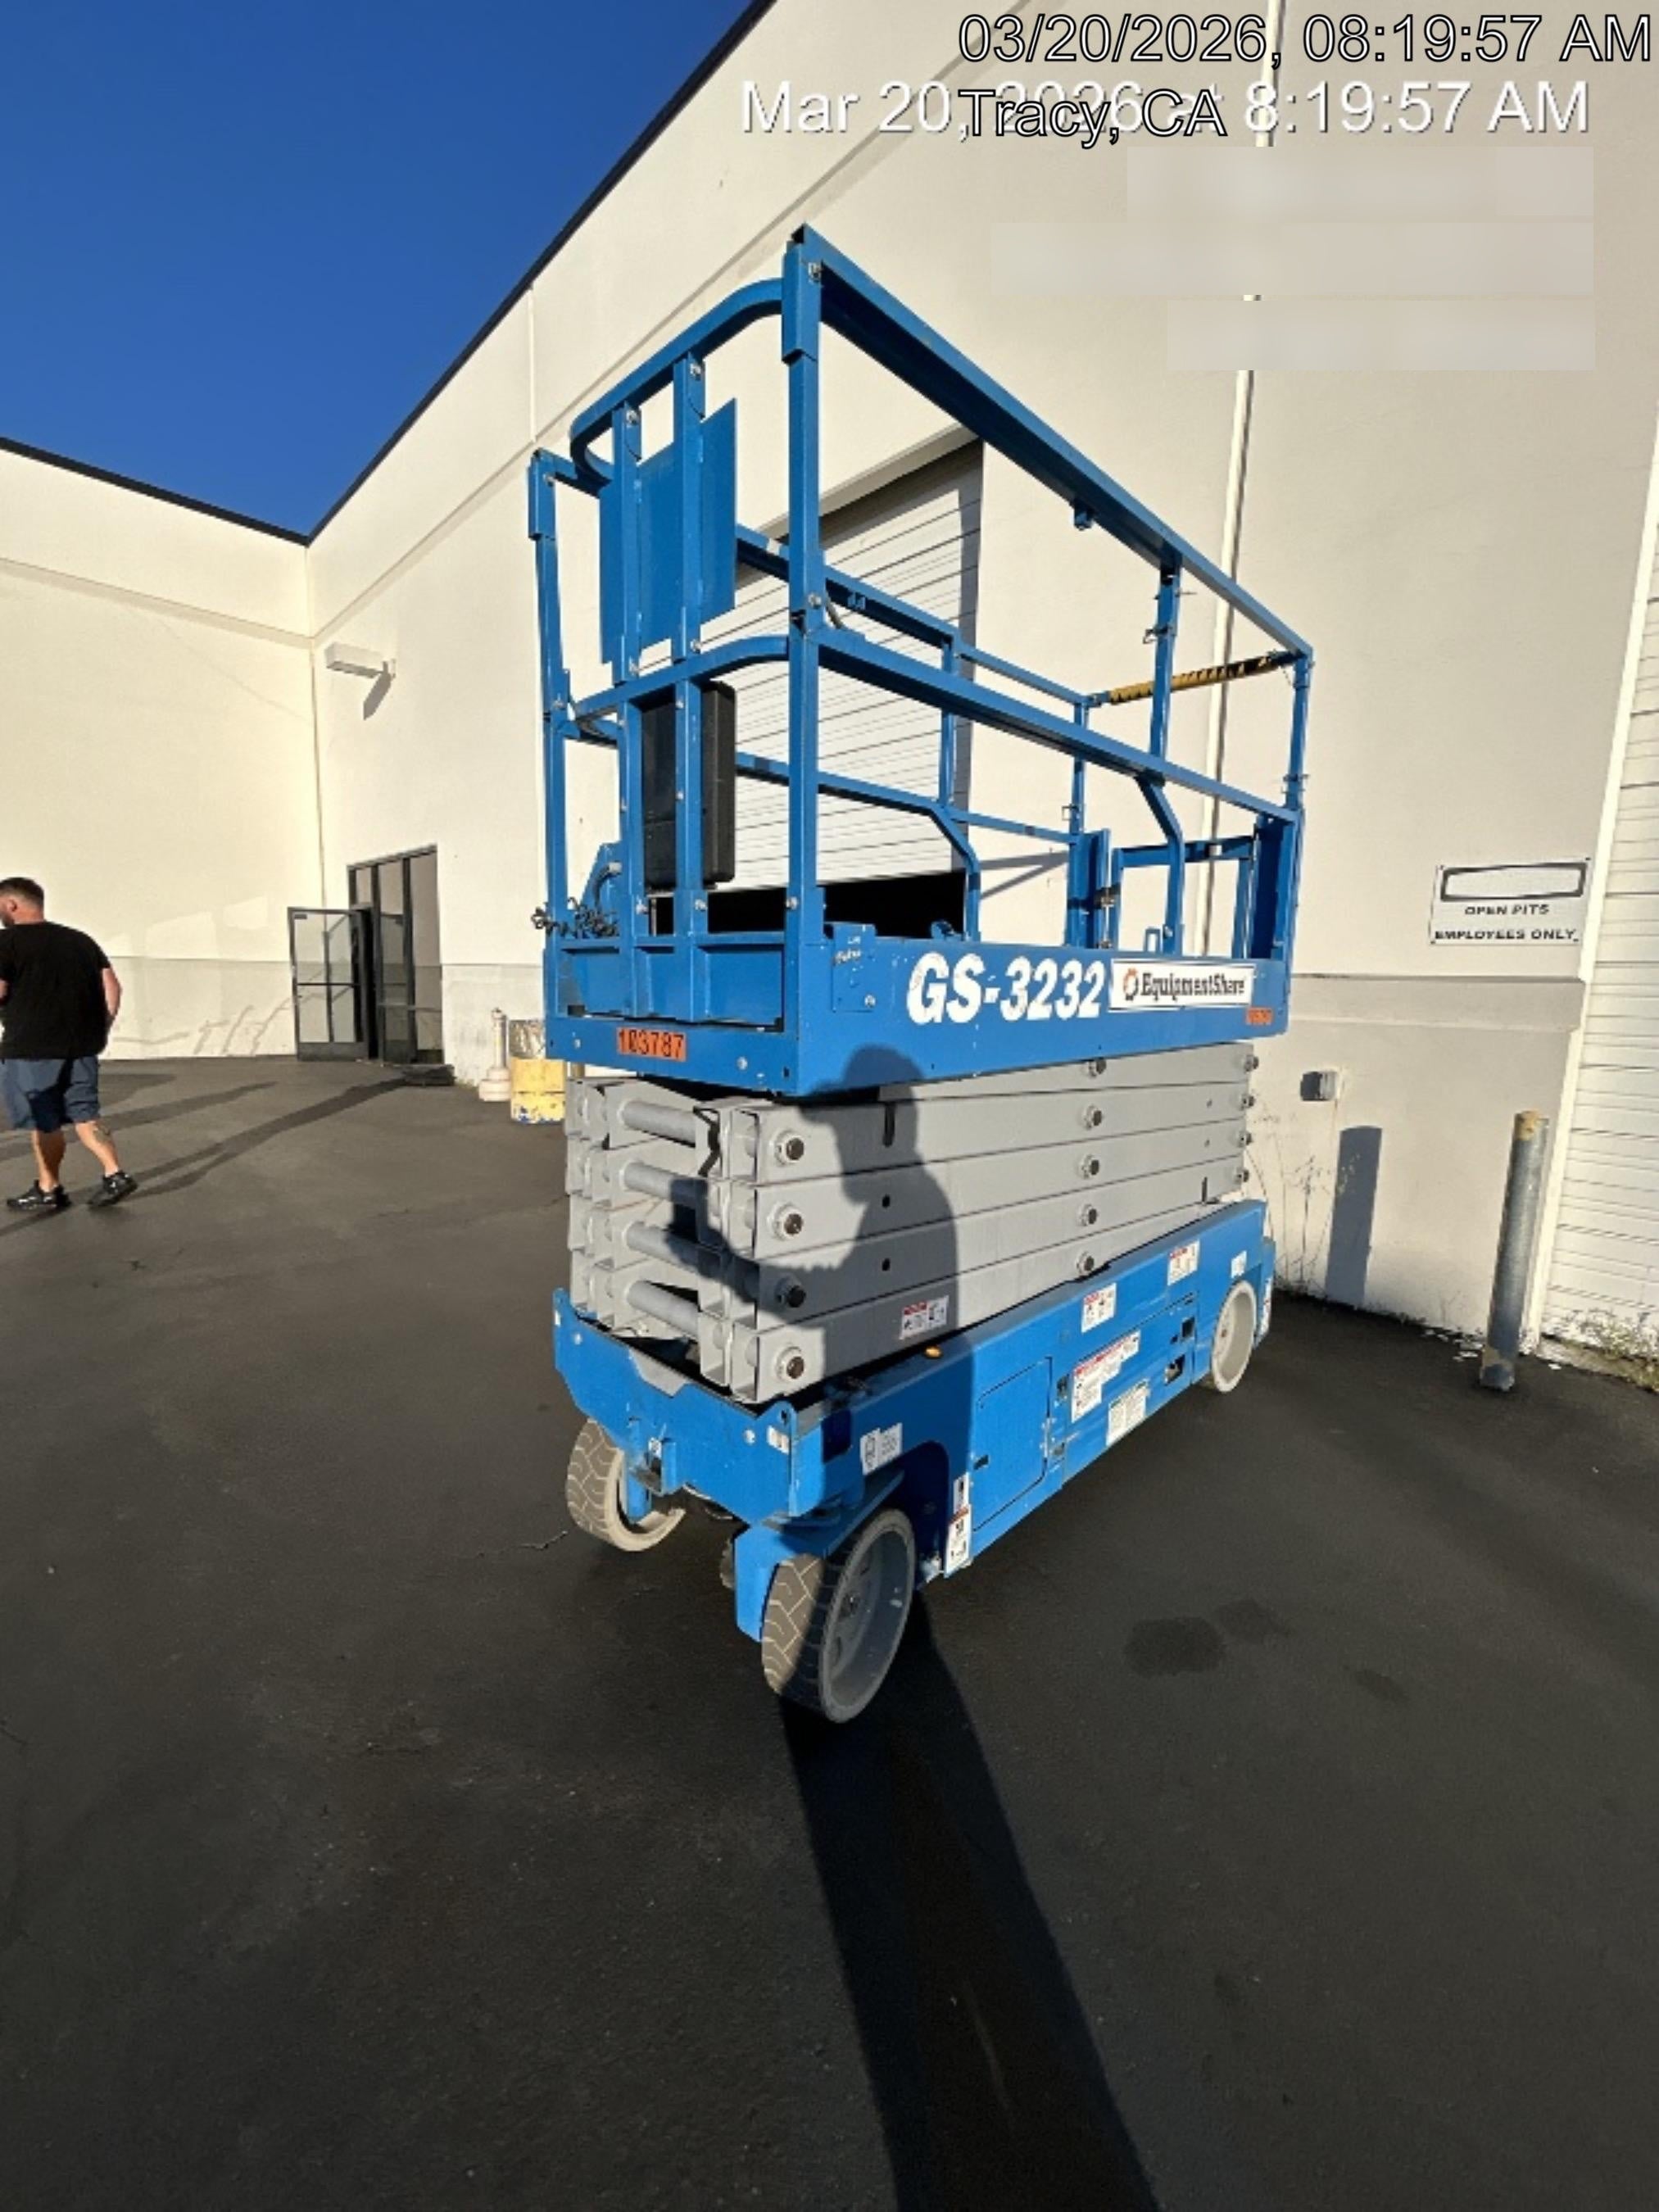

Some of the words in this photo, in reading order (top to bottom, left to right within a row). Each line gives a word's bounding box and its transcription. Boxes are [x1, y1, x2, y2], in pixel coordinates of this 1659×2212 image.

[1465, 906, 1507, 915] OPEN
[1512, 904, 1549, 915] PITS
[1435, 930, 1525, 940] EMPLOYEES
[906, 951, 1105, 1025] GS-3232
[1140, 972, 1246, 1002] EquipmentShare
